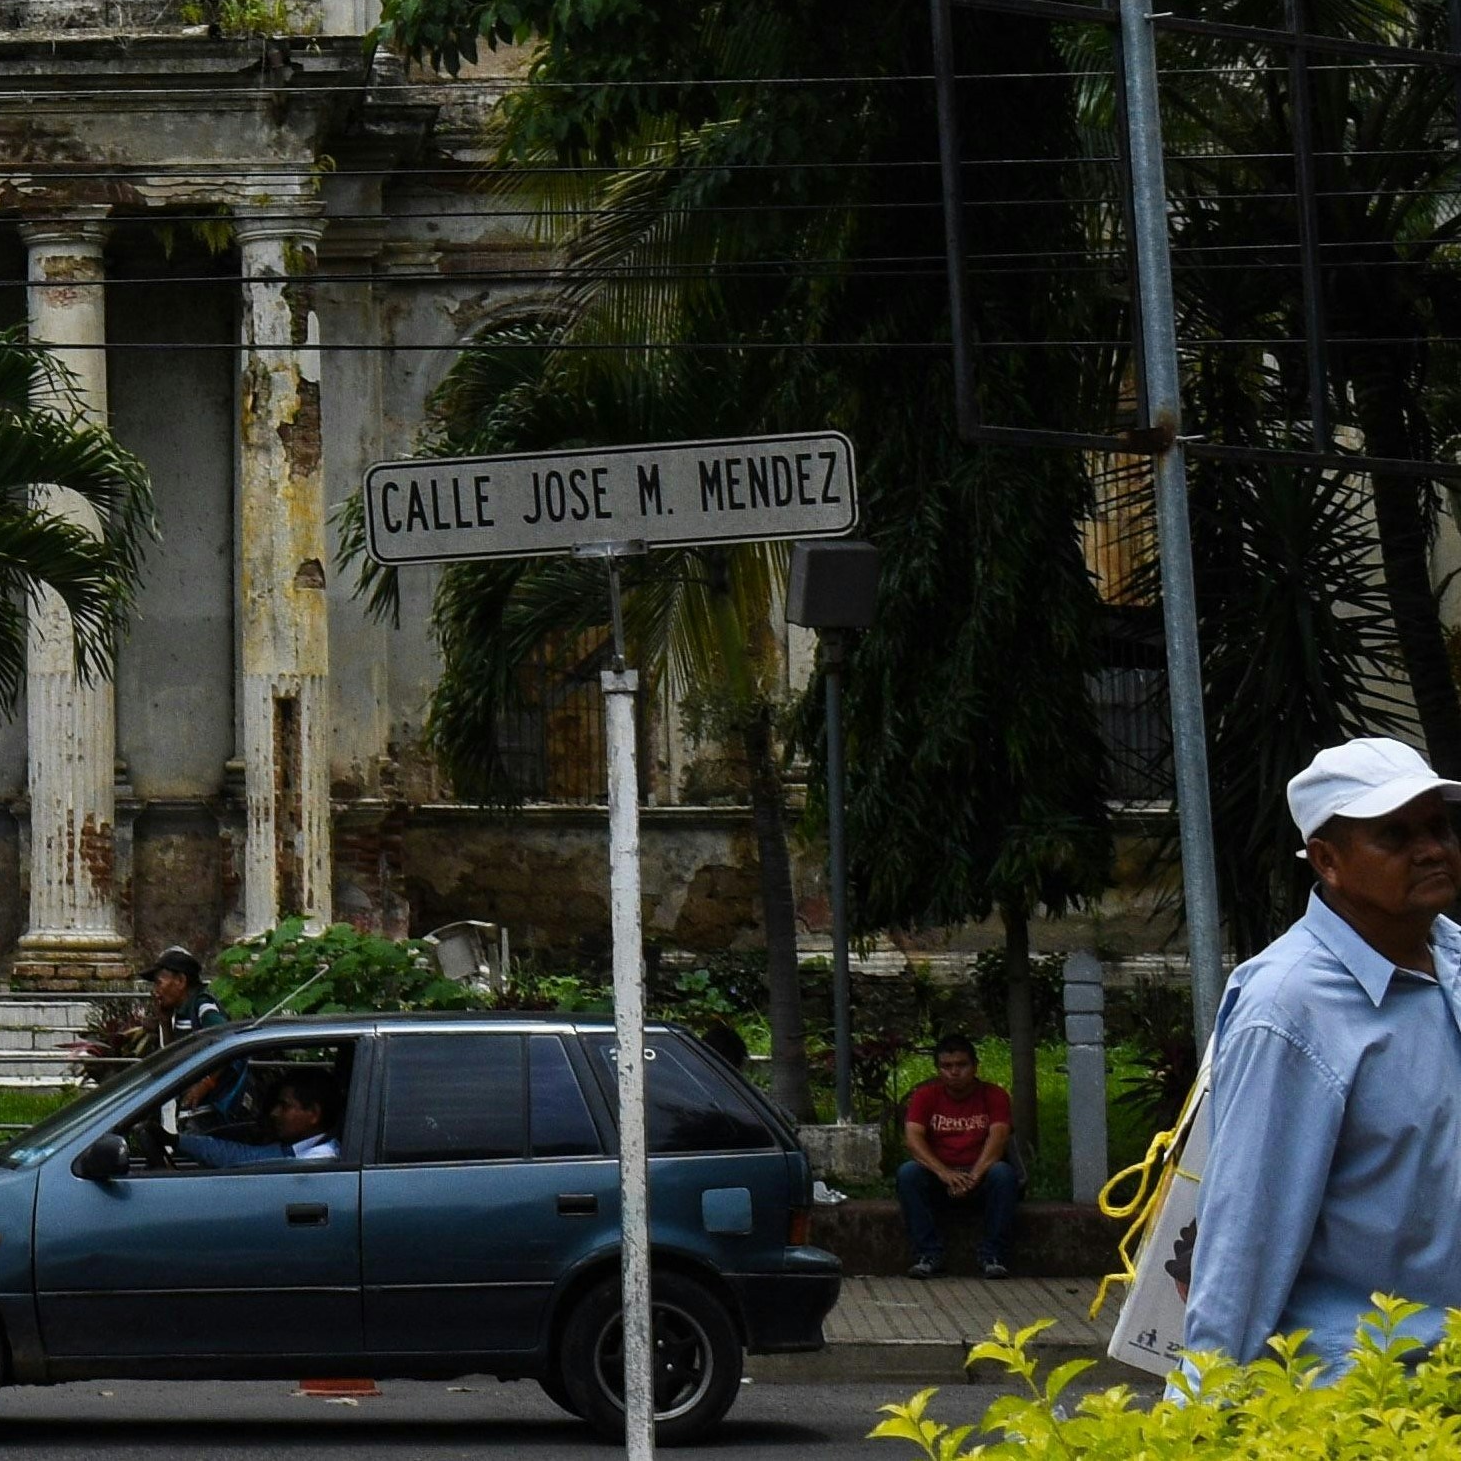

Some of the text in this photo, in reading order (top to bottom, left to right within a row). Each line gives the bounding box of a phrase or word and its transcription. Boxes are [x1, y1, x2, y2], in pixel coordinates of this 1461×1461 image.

[381, 451, 841, 534] CALLE JOSE M. MENDEZ
